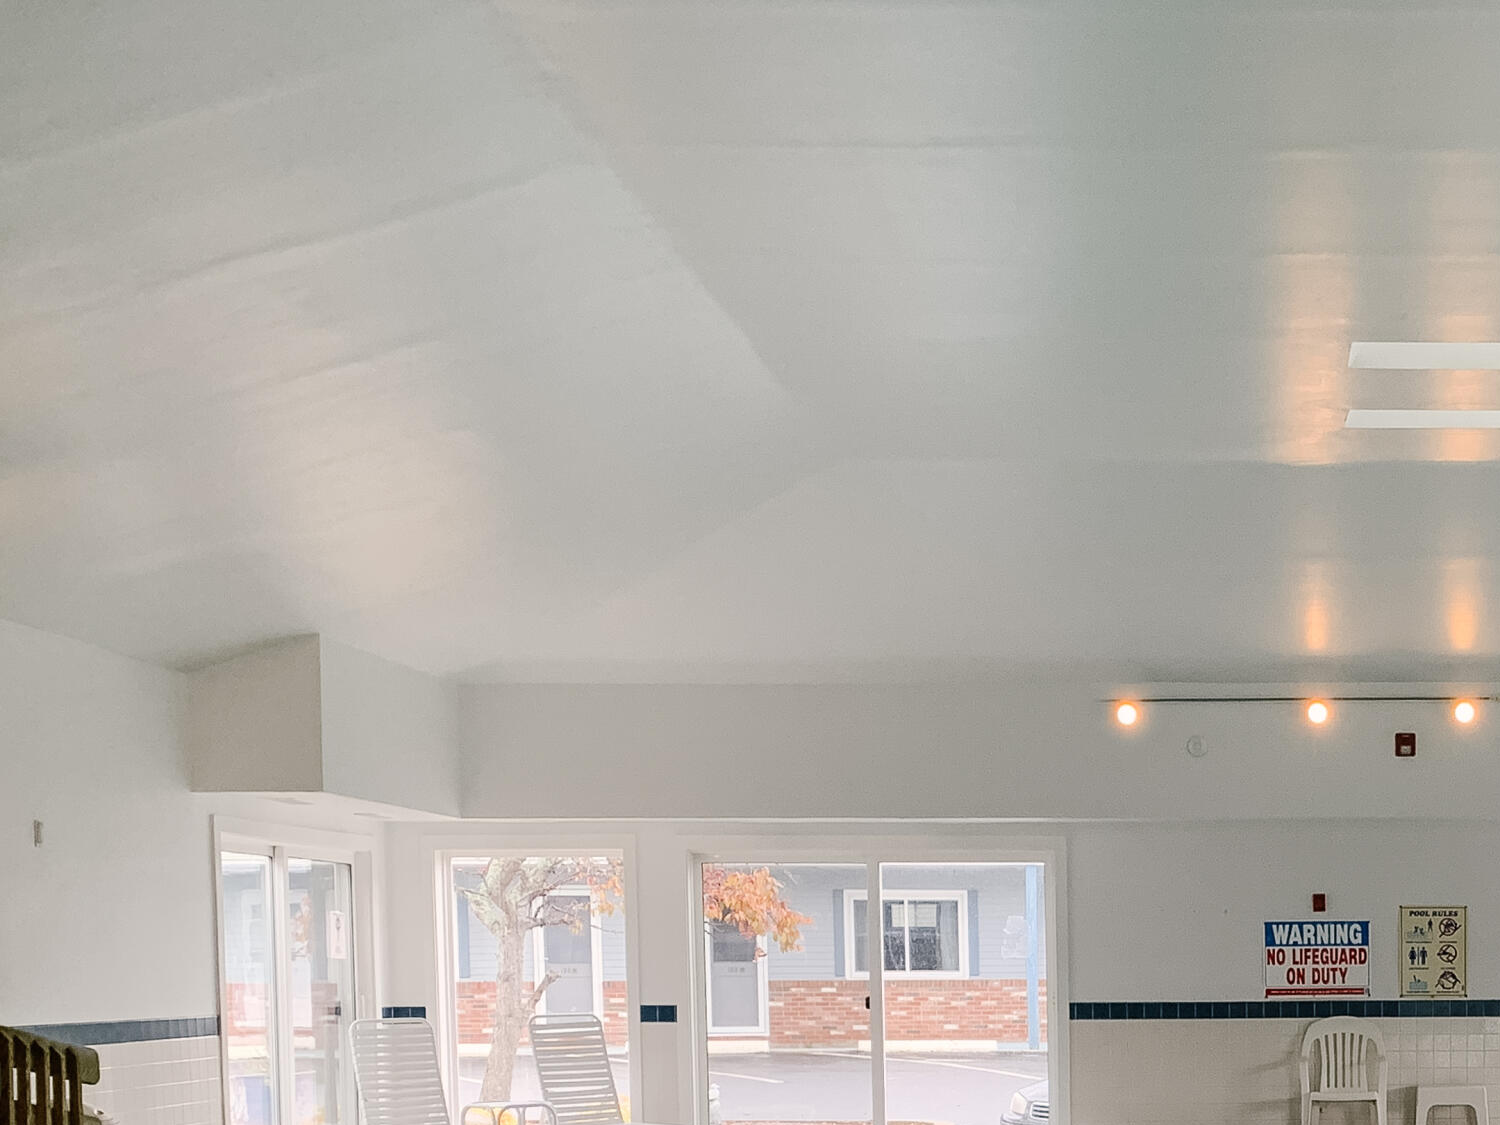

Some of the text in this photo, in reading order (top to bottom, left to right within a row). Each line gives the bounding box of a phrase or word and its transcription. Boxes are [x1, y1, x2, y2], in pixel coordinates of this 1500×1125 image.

[1272, 923, 1362, 945] WARNING
[1267, 948, 1367, 966] NO LIFEGUARD
[1286, 967, 1348, 985] ON DUTY
